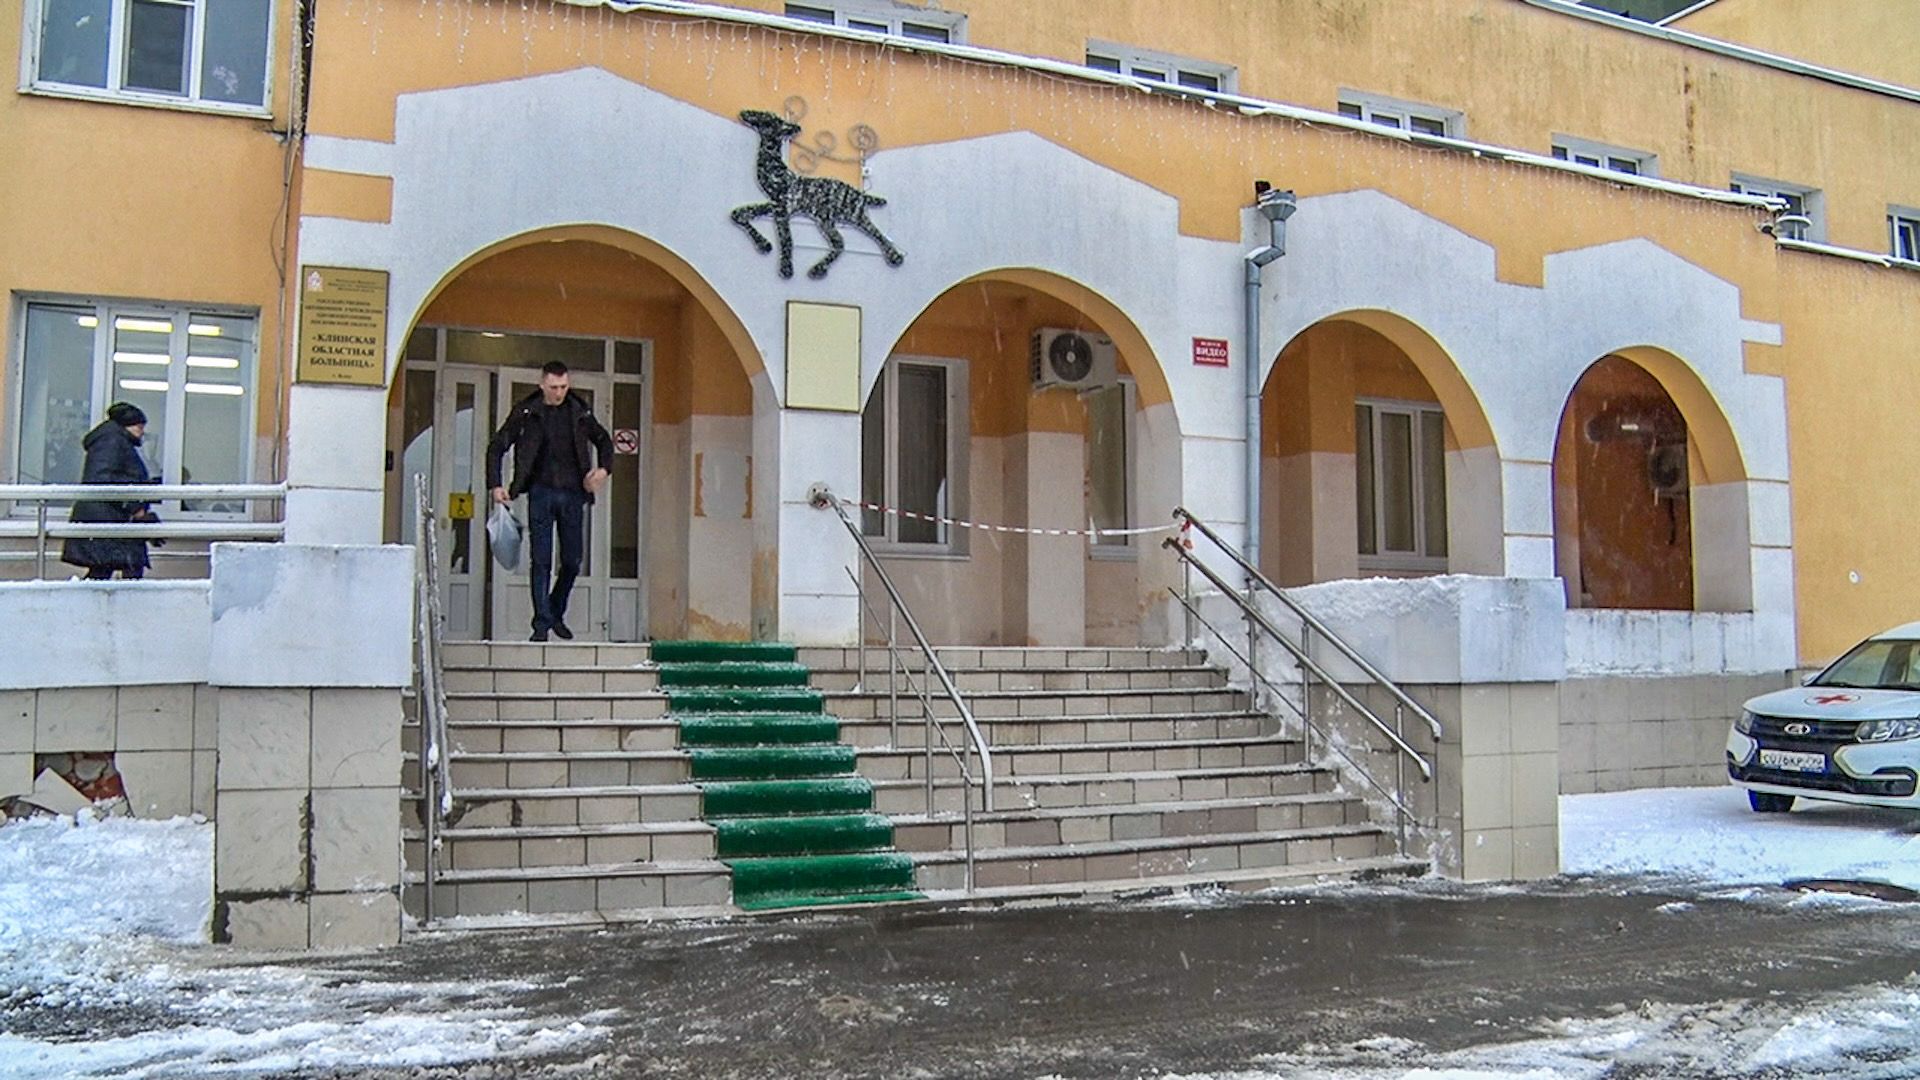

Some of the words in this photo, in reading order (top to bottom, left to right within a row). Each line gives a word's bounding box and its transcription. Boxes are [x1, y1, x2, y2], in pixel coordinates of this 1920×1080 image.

[312, 334, 376, 344] «КЛИНСКАЯ
[311, 345, 375, 357] ОБЛАСТНАЯ
[1196, 346, 1226, 358] ВИДЕО
[310, 357, 375, 369] БОЛЬНИЦА»
